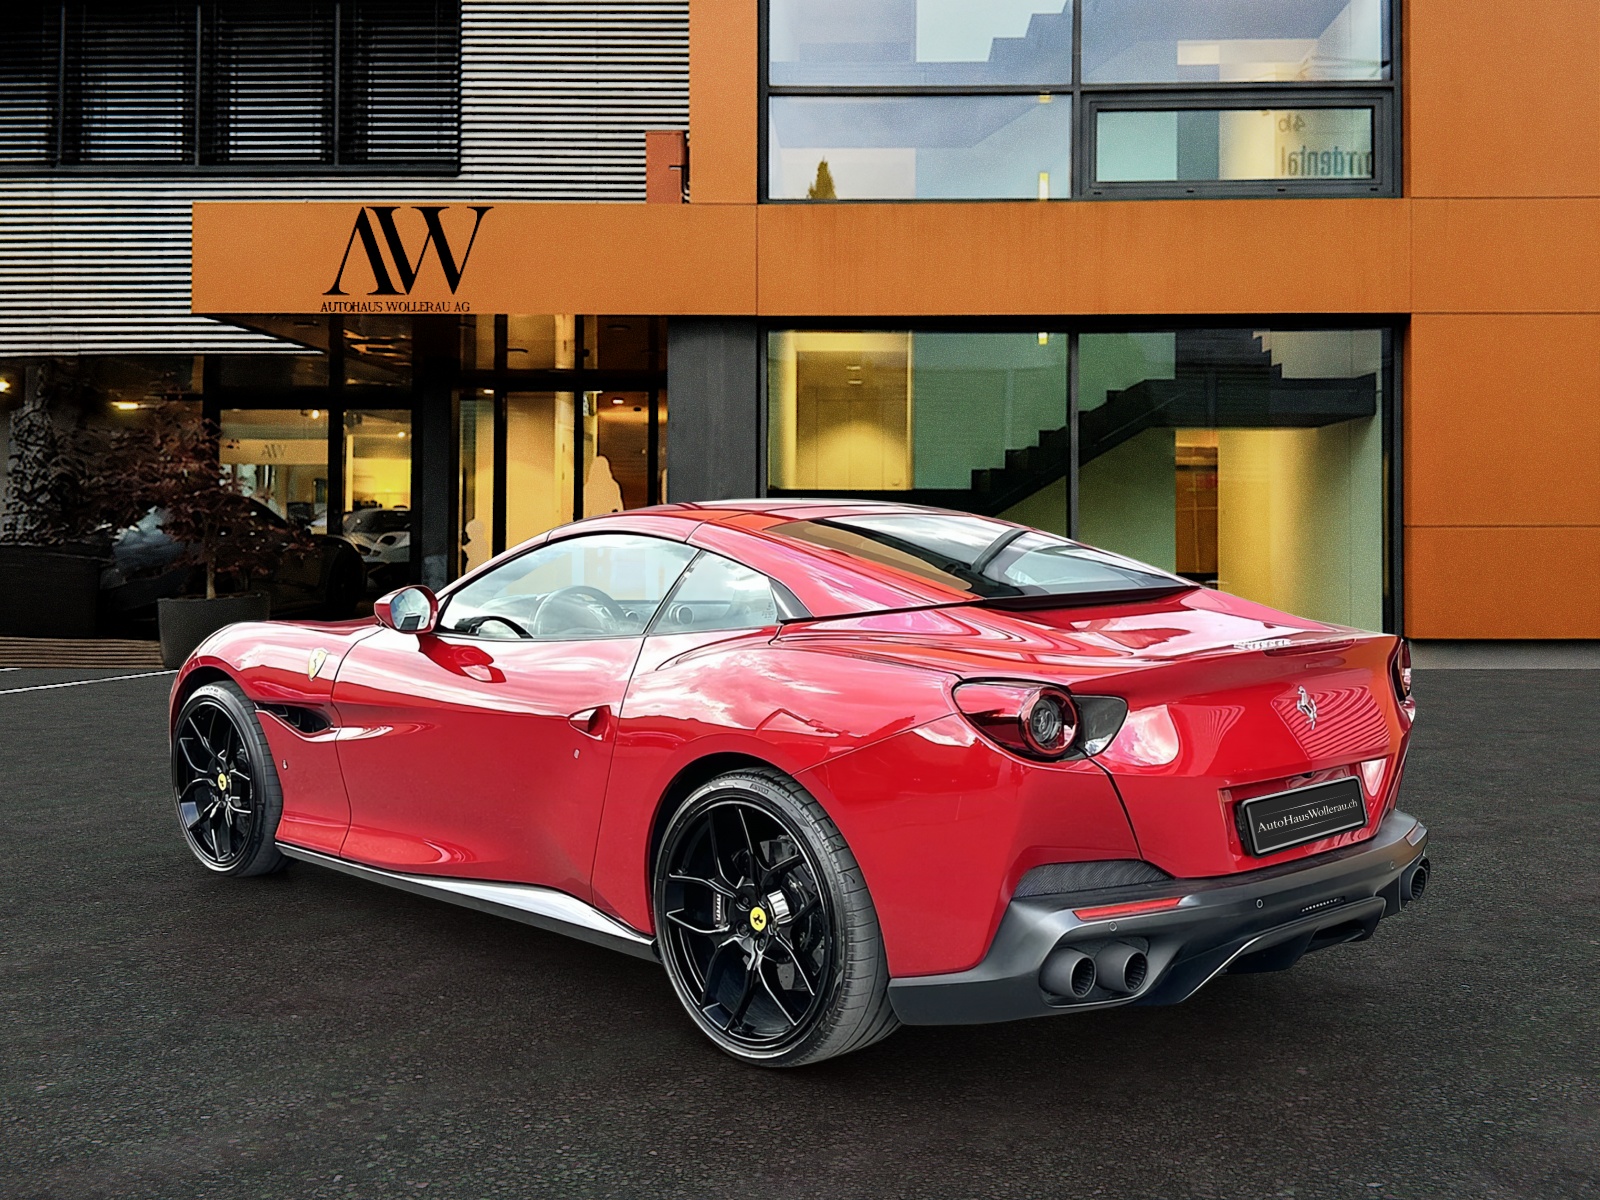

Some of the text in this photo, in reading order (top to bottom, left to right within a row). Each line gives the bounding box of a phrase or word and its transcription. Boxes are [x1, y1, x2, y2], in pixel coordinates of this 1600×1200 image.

[322, 206, 494, 295] AW
[320, 301, 471, 313] AUTOHAUS WOLLERAU AG
[1257, 798, 1358, 833] AutoHausWollerau.ch
